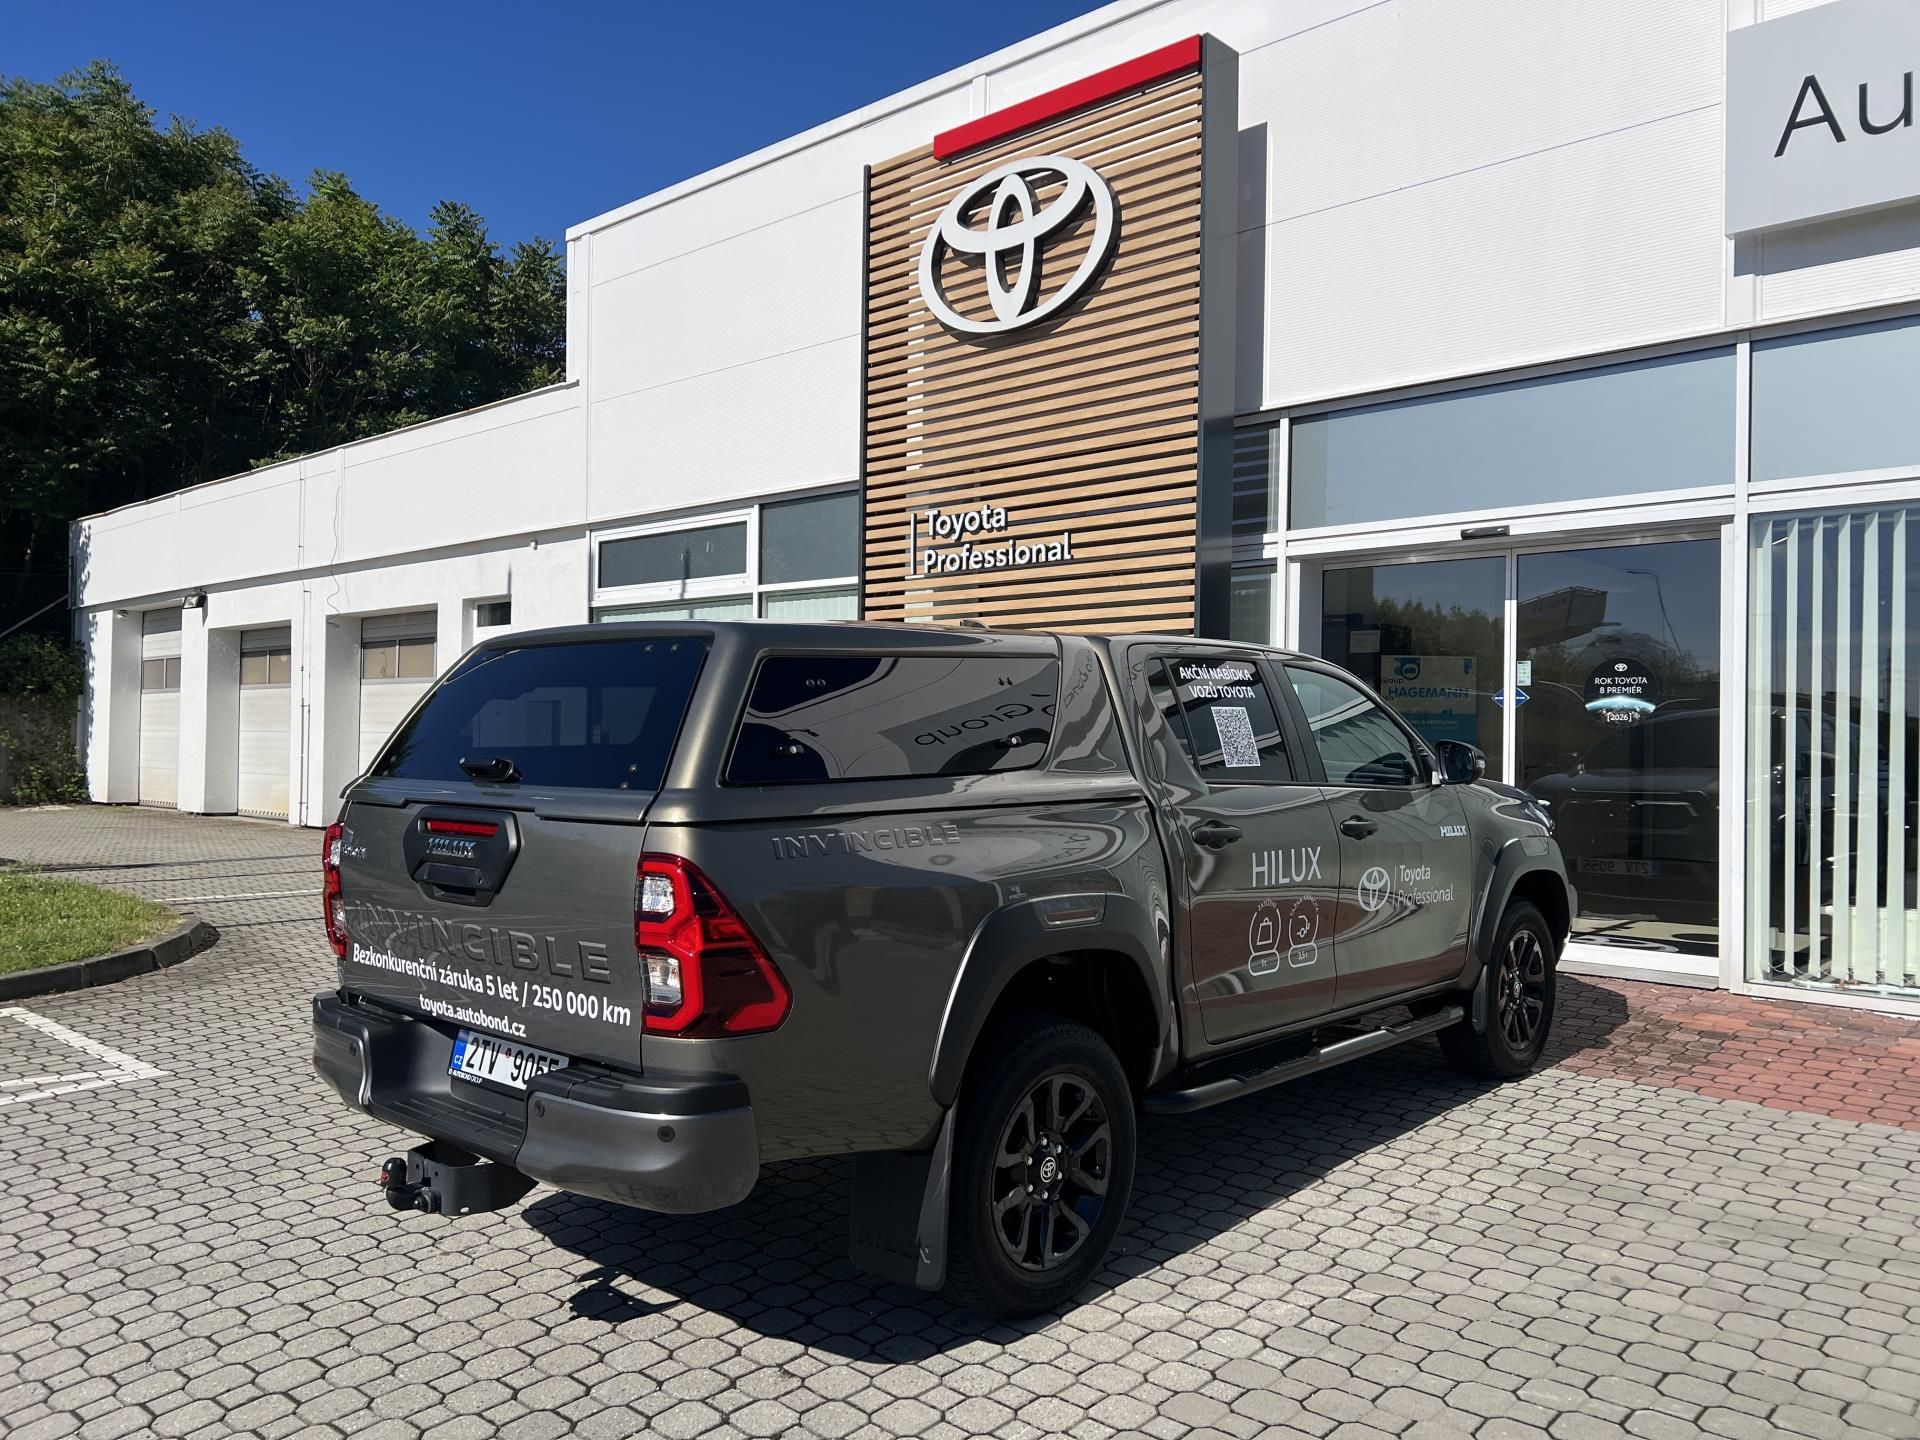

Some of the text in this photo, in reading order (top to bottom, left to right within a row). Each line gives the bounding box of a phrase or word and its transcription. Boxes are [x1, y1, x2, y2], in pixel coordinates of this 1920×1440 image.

[1773, 70, 1913, 158] Au
[924, 504, 1007, 541] Toyota
[924, 531, 1073, 574] Professional
[1179, 663, 1253, 681] AKČNÍ NABÍDKA
[1594, 676, 1648, 685] ROK TOYOTA
[1188, 680, 1256, 699] VOZŮ TOYOTA
[1388, 686, 1470, 699] HAGEMANN
[1606, 685, 1642, 694] PREMIÉR
[772, 824, 962, 860] INVINCIBLE
[1439, 824, 1467, 837] HILUX
[1251, 846, 1322, 888] HILUX
[1399, 864, 1431, 887] Toyota
[1397, 883, 1454, 908] Professional
[354, 899, 612, 985] INVINCIBLE
[352, 942, 631, 1027] Bezkonkurenční záruka 5 let / 250 000 km
[419, 993, 527, 1038] toyota.autobond.cz
[454, 1054, 463, 1065] CZ
[465, 1036, 501, 1075] 2TV
